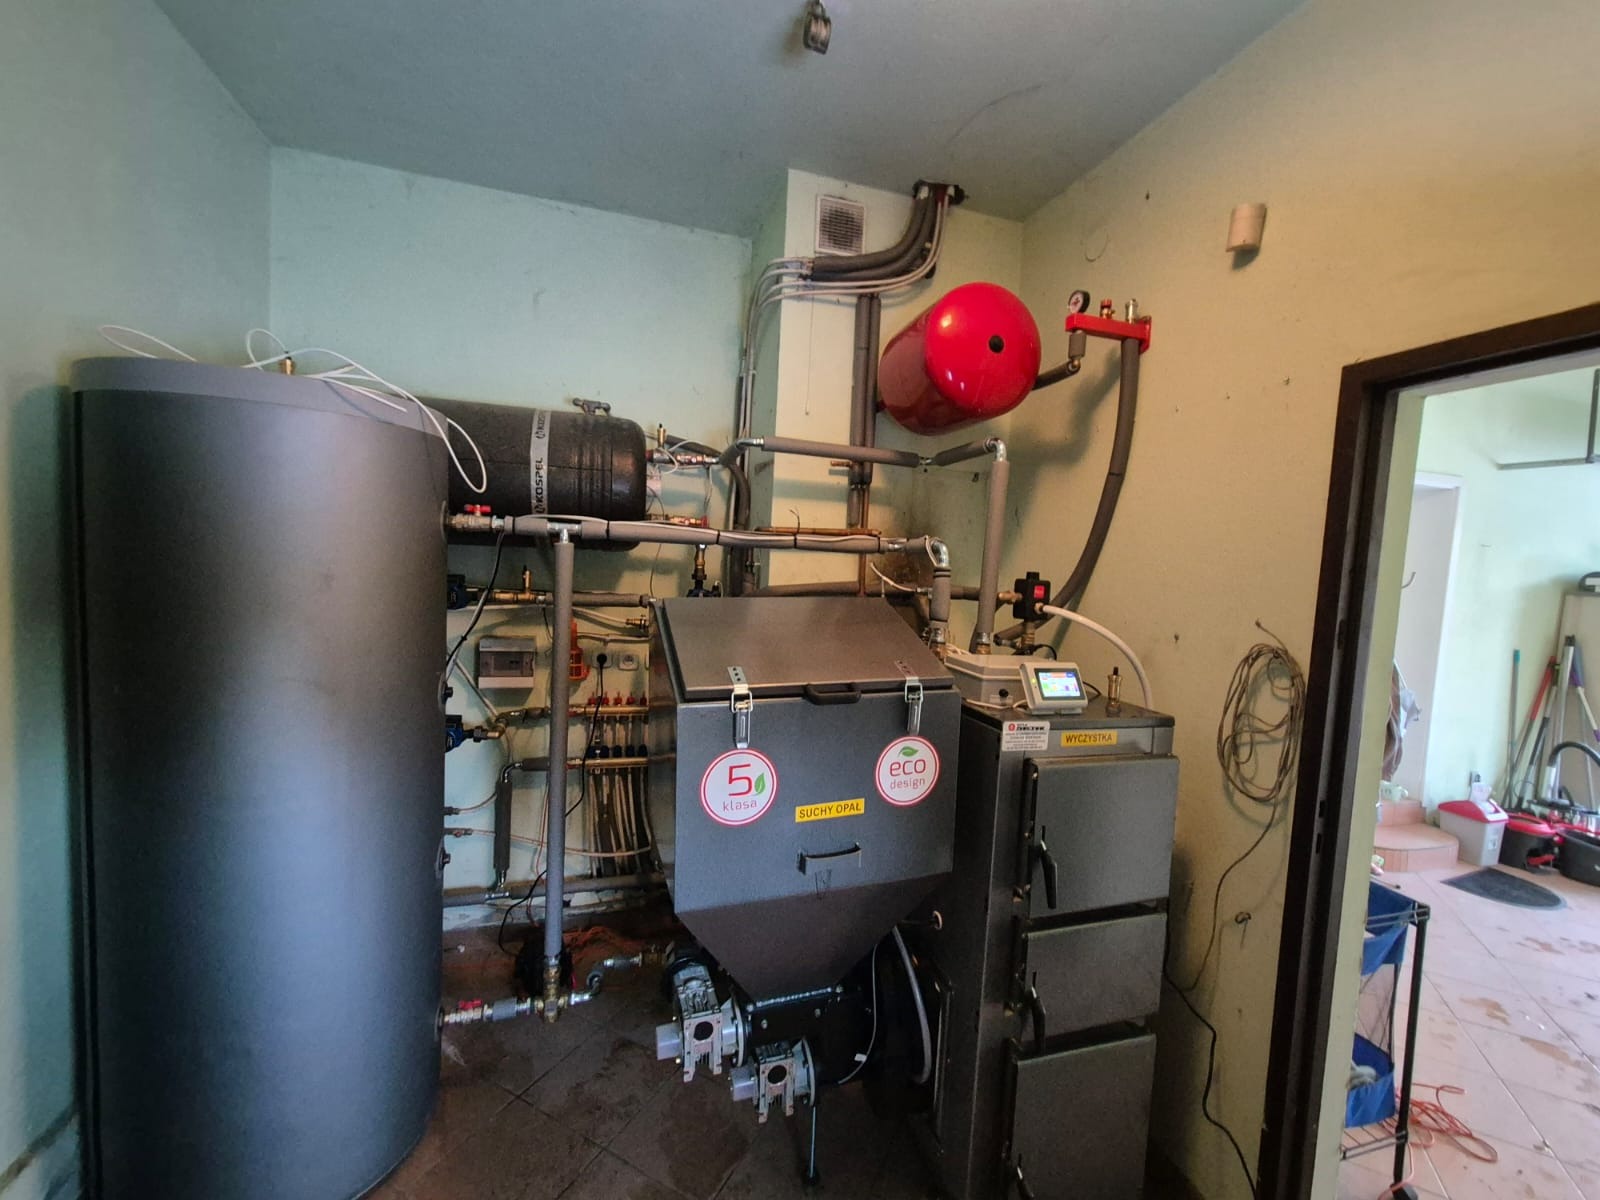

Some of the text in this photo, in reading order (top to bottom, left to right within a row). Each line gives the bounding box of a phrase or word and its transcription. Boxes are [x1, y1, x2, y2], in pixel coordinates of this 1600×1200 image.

[535, 457, 544, 504] KOSPEL
[1065, 732, 1113, 744] WYCZYSTKA
[890, 759, 926, 777] eco
[728, 763, 753, 797] 5
[890, 778, 926, 790] design
[723, 799, 758, 812] klasa
[799, 805, 834, 819] SUCHY
